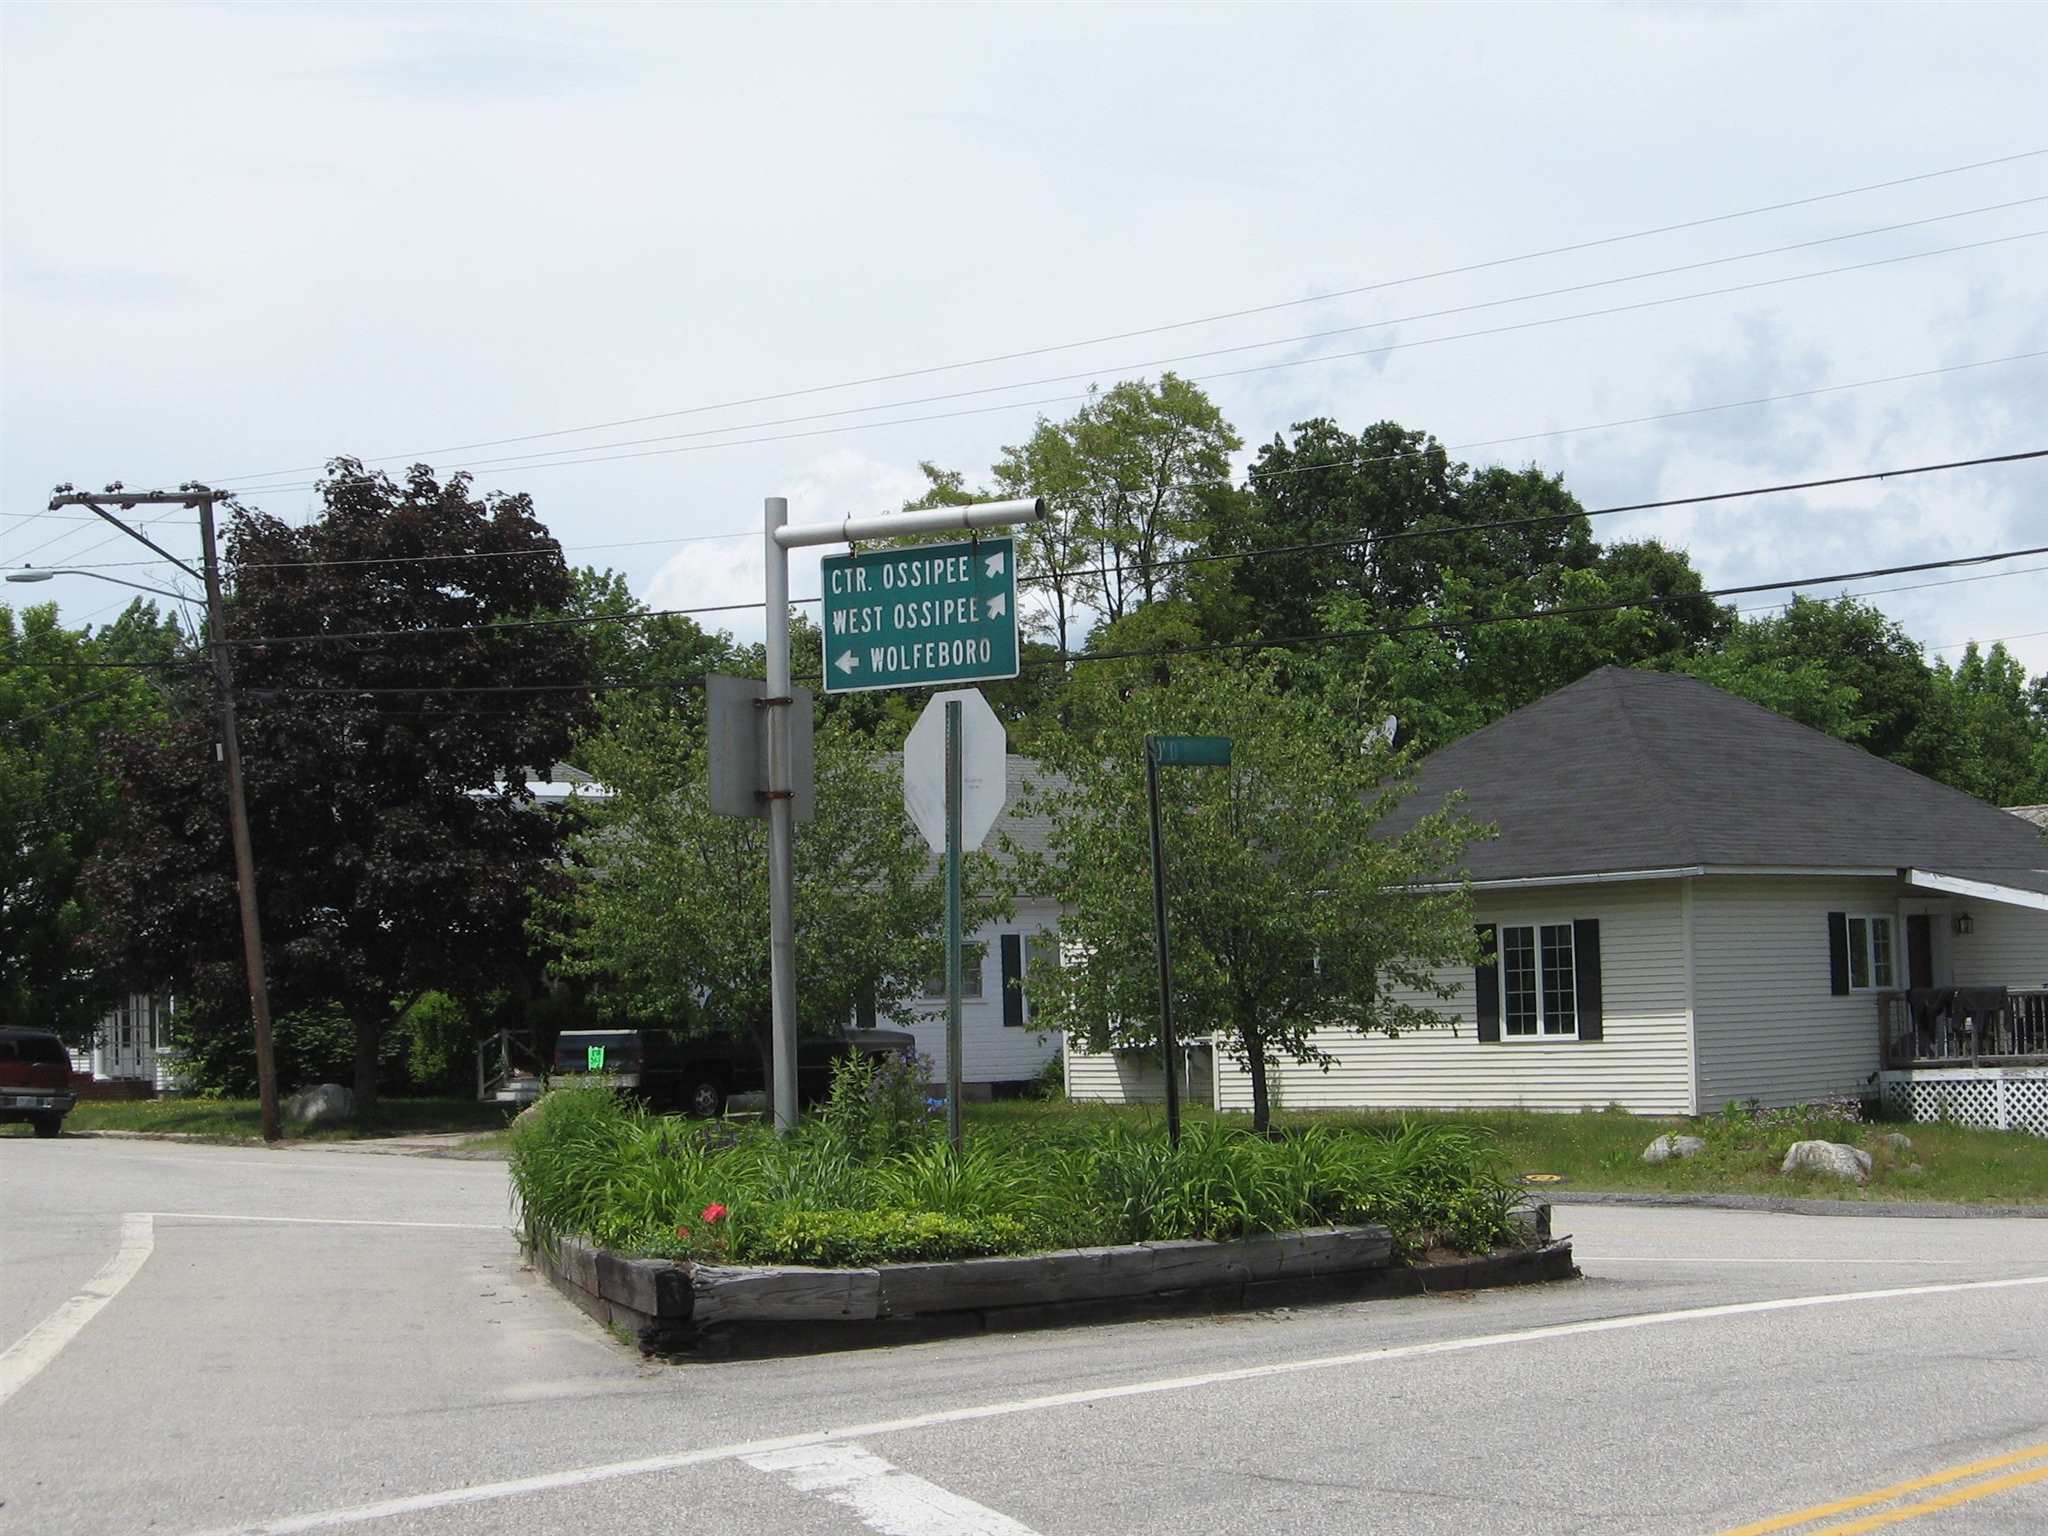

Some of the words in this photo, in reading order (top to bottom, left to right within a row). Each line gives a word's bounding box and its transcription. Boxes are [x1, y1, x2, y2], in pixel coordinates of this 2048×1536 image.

[831, 566, 873, 594] CTR.
[882, 556, 969, 589] OSSIPEE
[832, 606, 883, 635] WEST
[893, 597, 980, 630] OSSIPEE
[870, 638, 991, 673] WOLFEBORO
